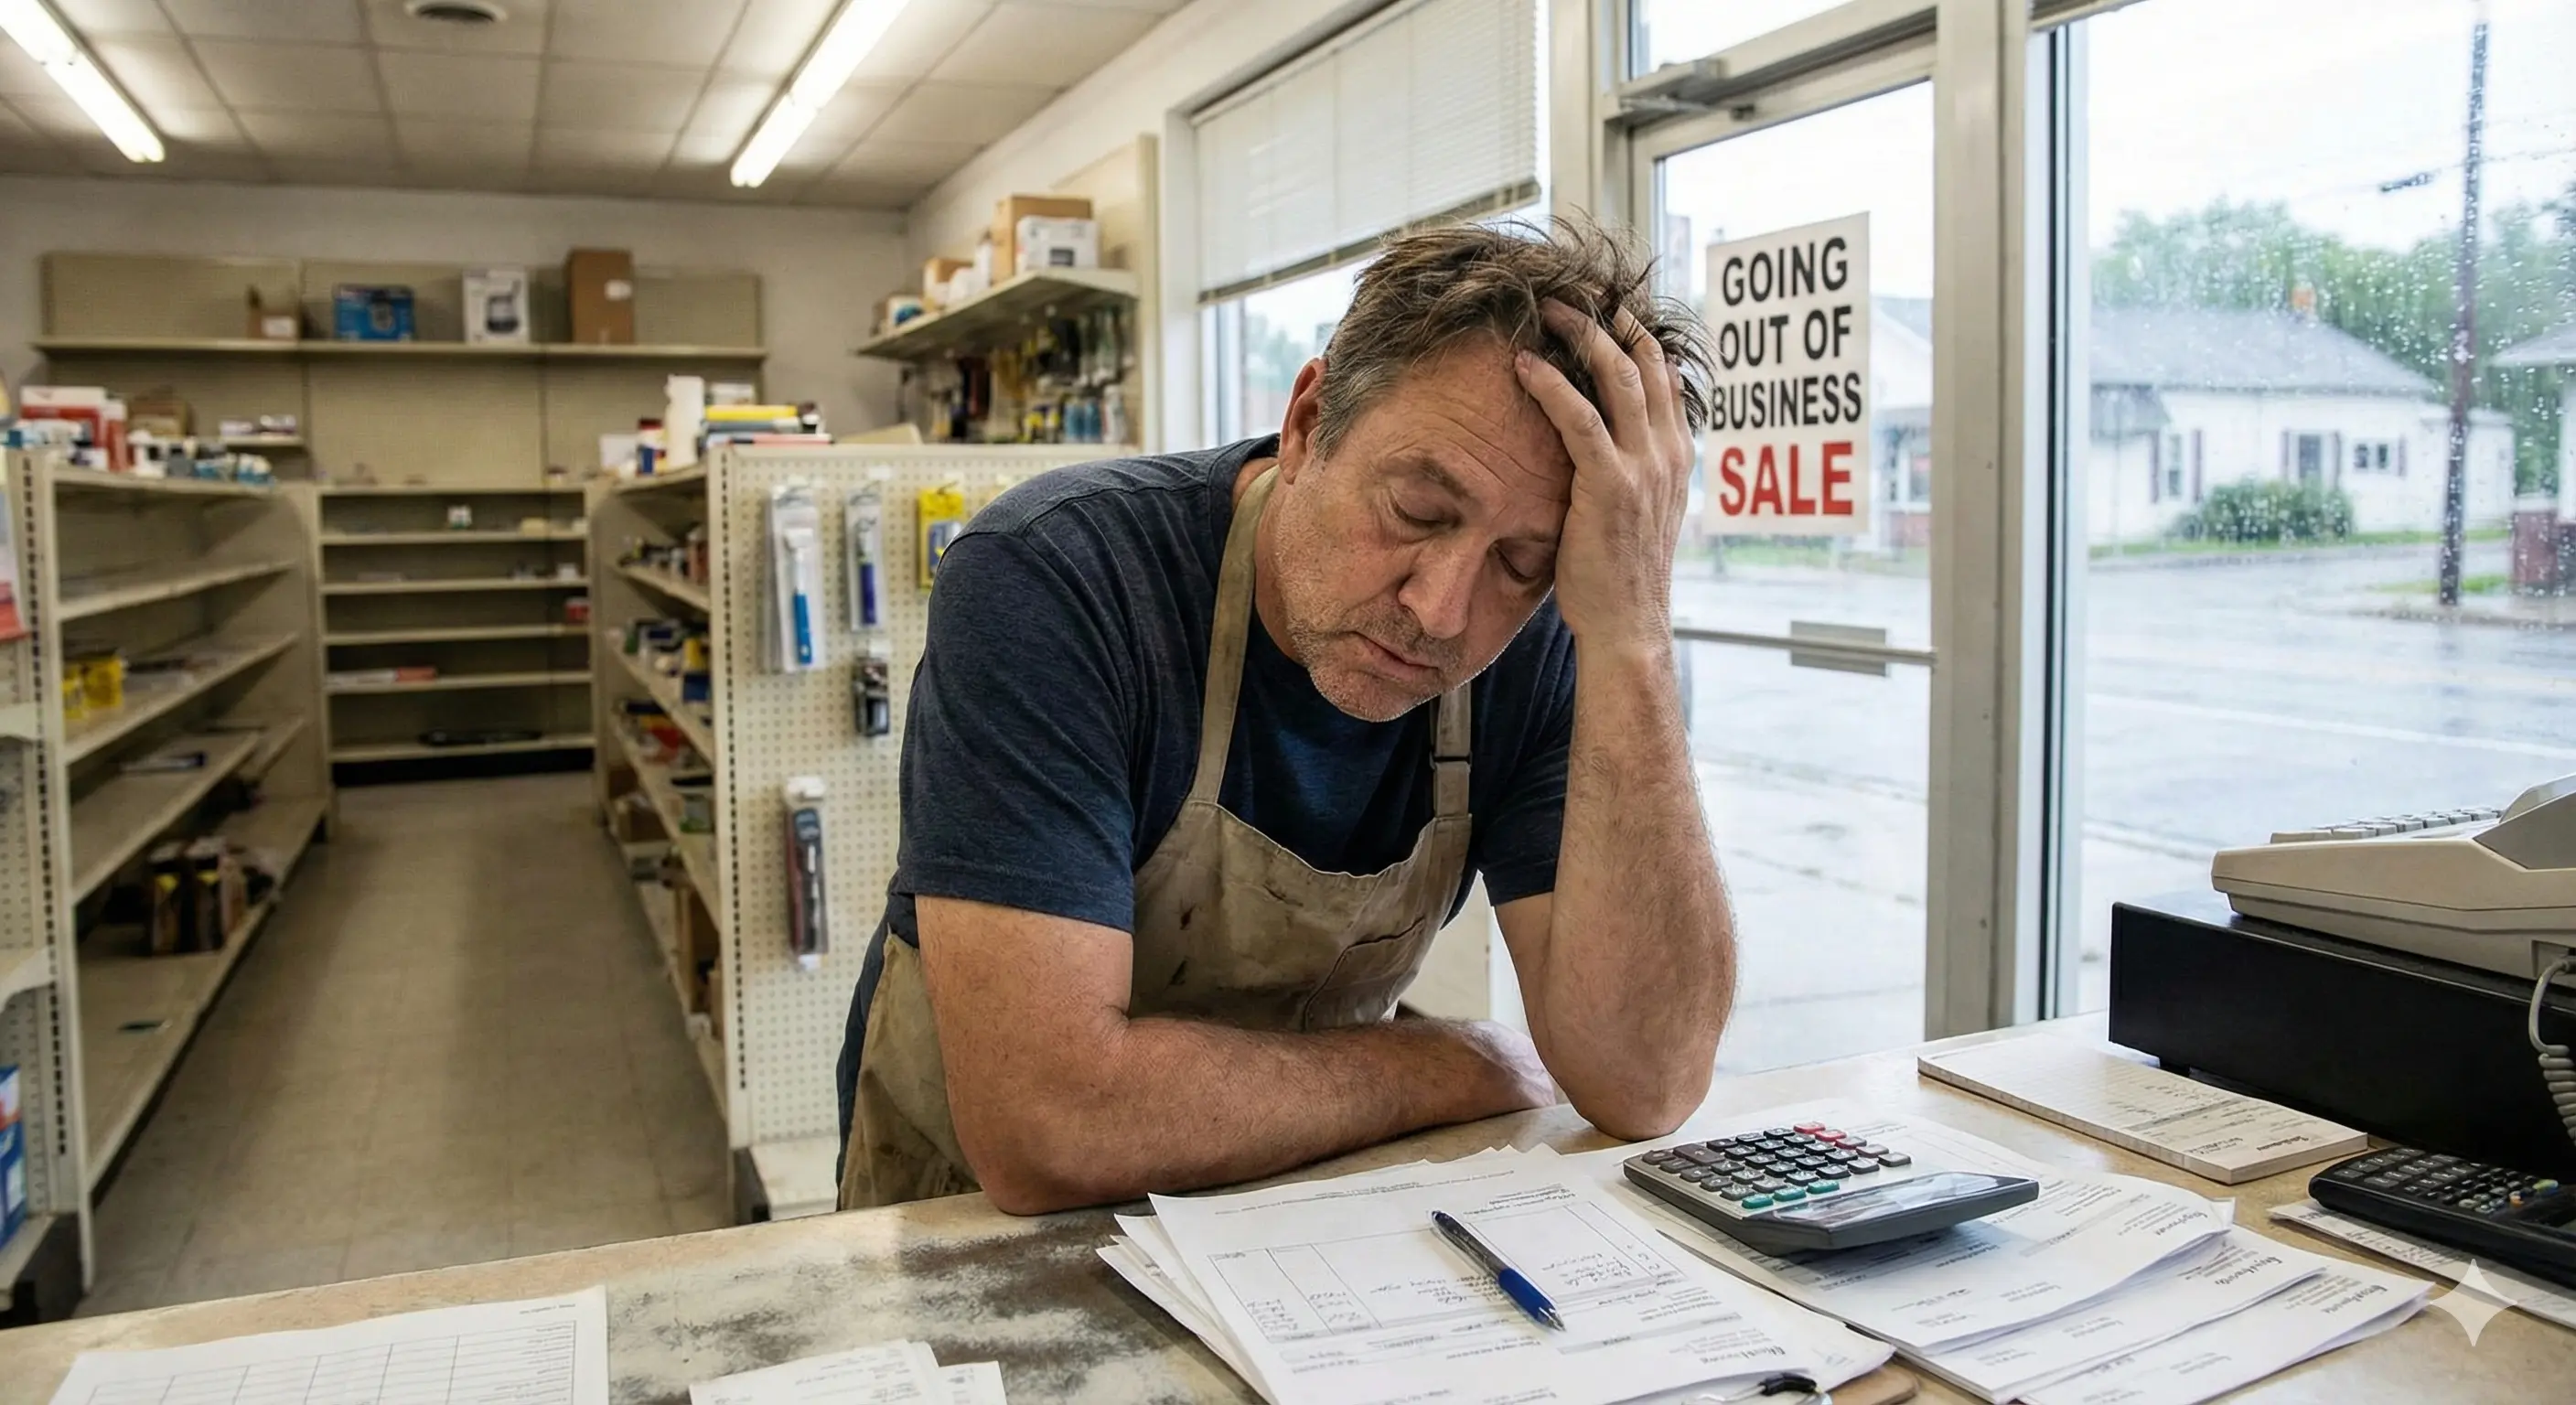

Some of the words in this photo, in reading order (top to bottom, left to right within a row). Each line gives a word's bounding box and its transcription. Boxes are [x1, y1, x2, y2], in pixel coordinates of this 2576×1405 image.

[1723, 236, 1847, 306] GOING
[1720, 314, 1788, 370] OUT
[1804, 305, 1852, 361] OF
[1712, 371, 1862, 432] BUSINESS
[1720, 441, 1853, 517] SALE
